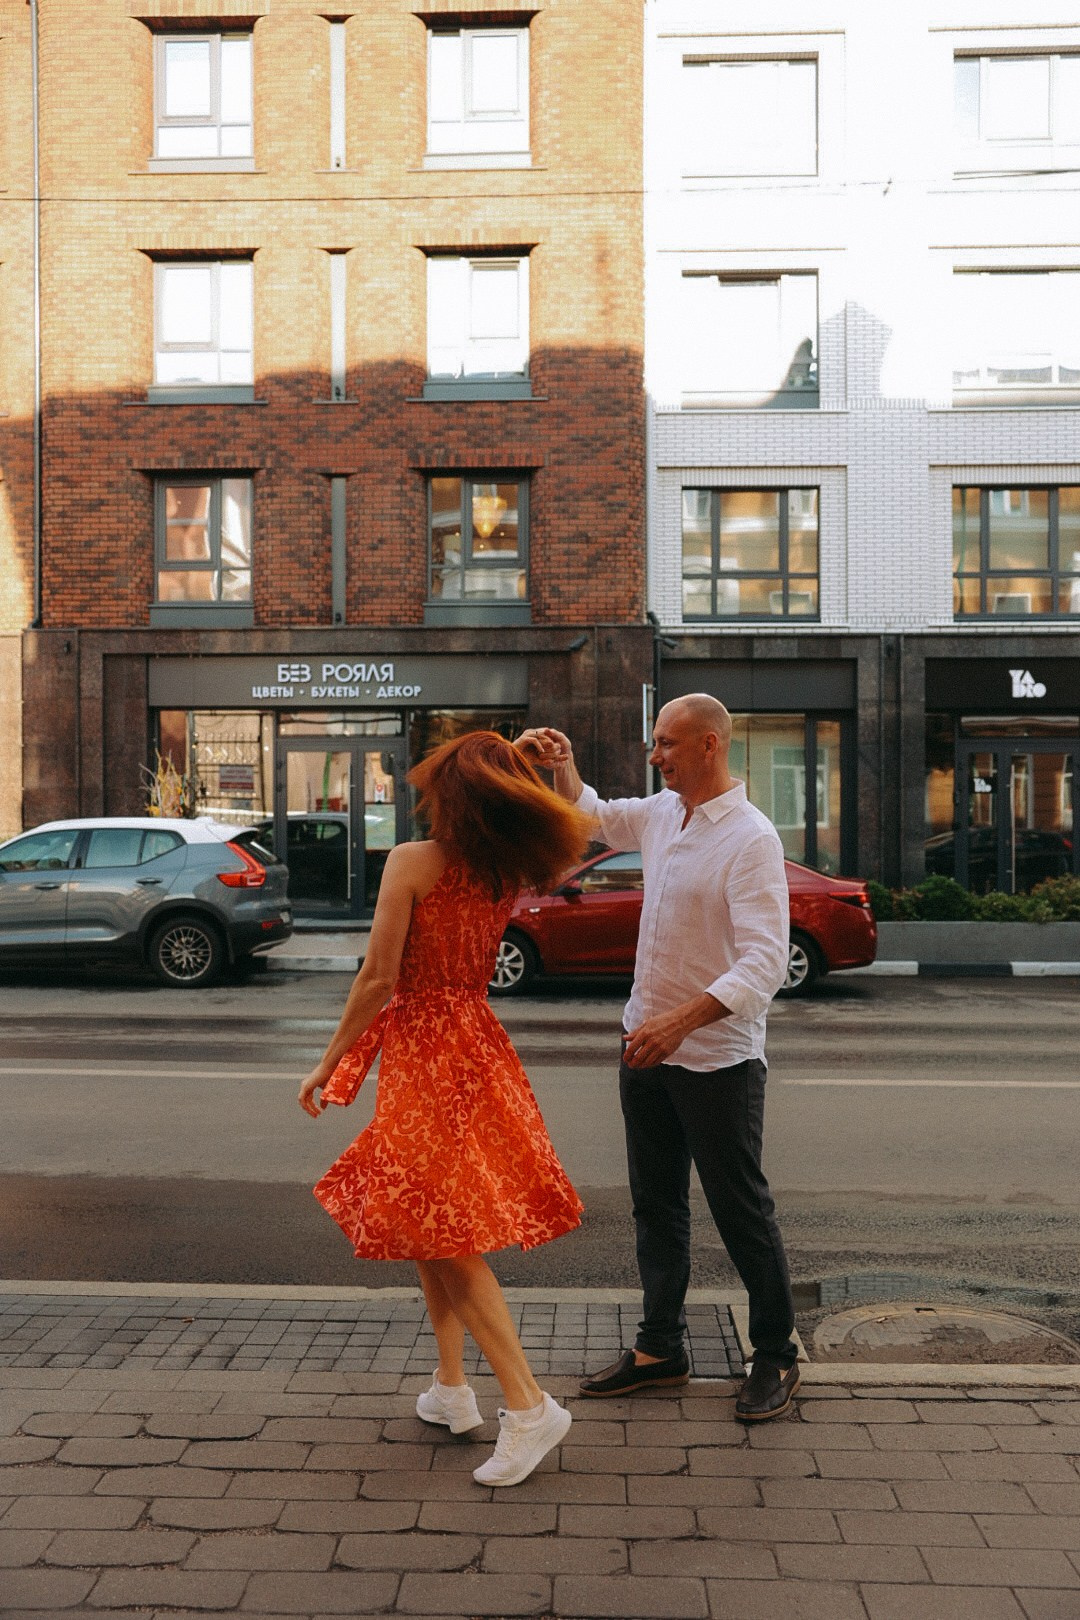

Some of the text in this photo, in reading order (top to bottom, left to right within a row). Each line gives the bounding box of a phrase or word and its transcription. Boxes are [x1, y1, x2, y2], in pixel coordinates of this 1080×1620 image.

[277, 664, 394, 682] БЕЗ РОЯЛЯ
[252, 685, 422, 699] ЦВЕТЫ БУКЕТЫ ДЕКОР
